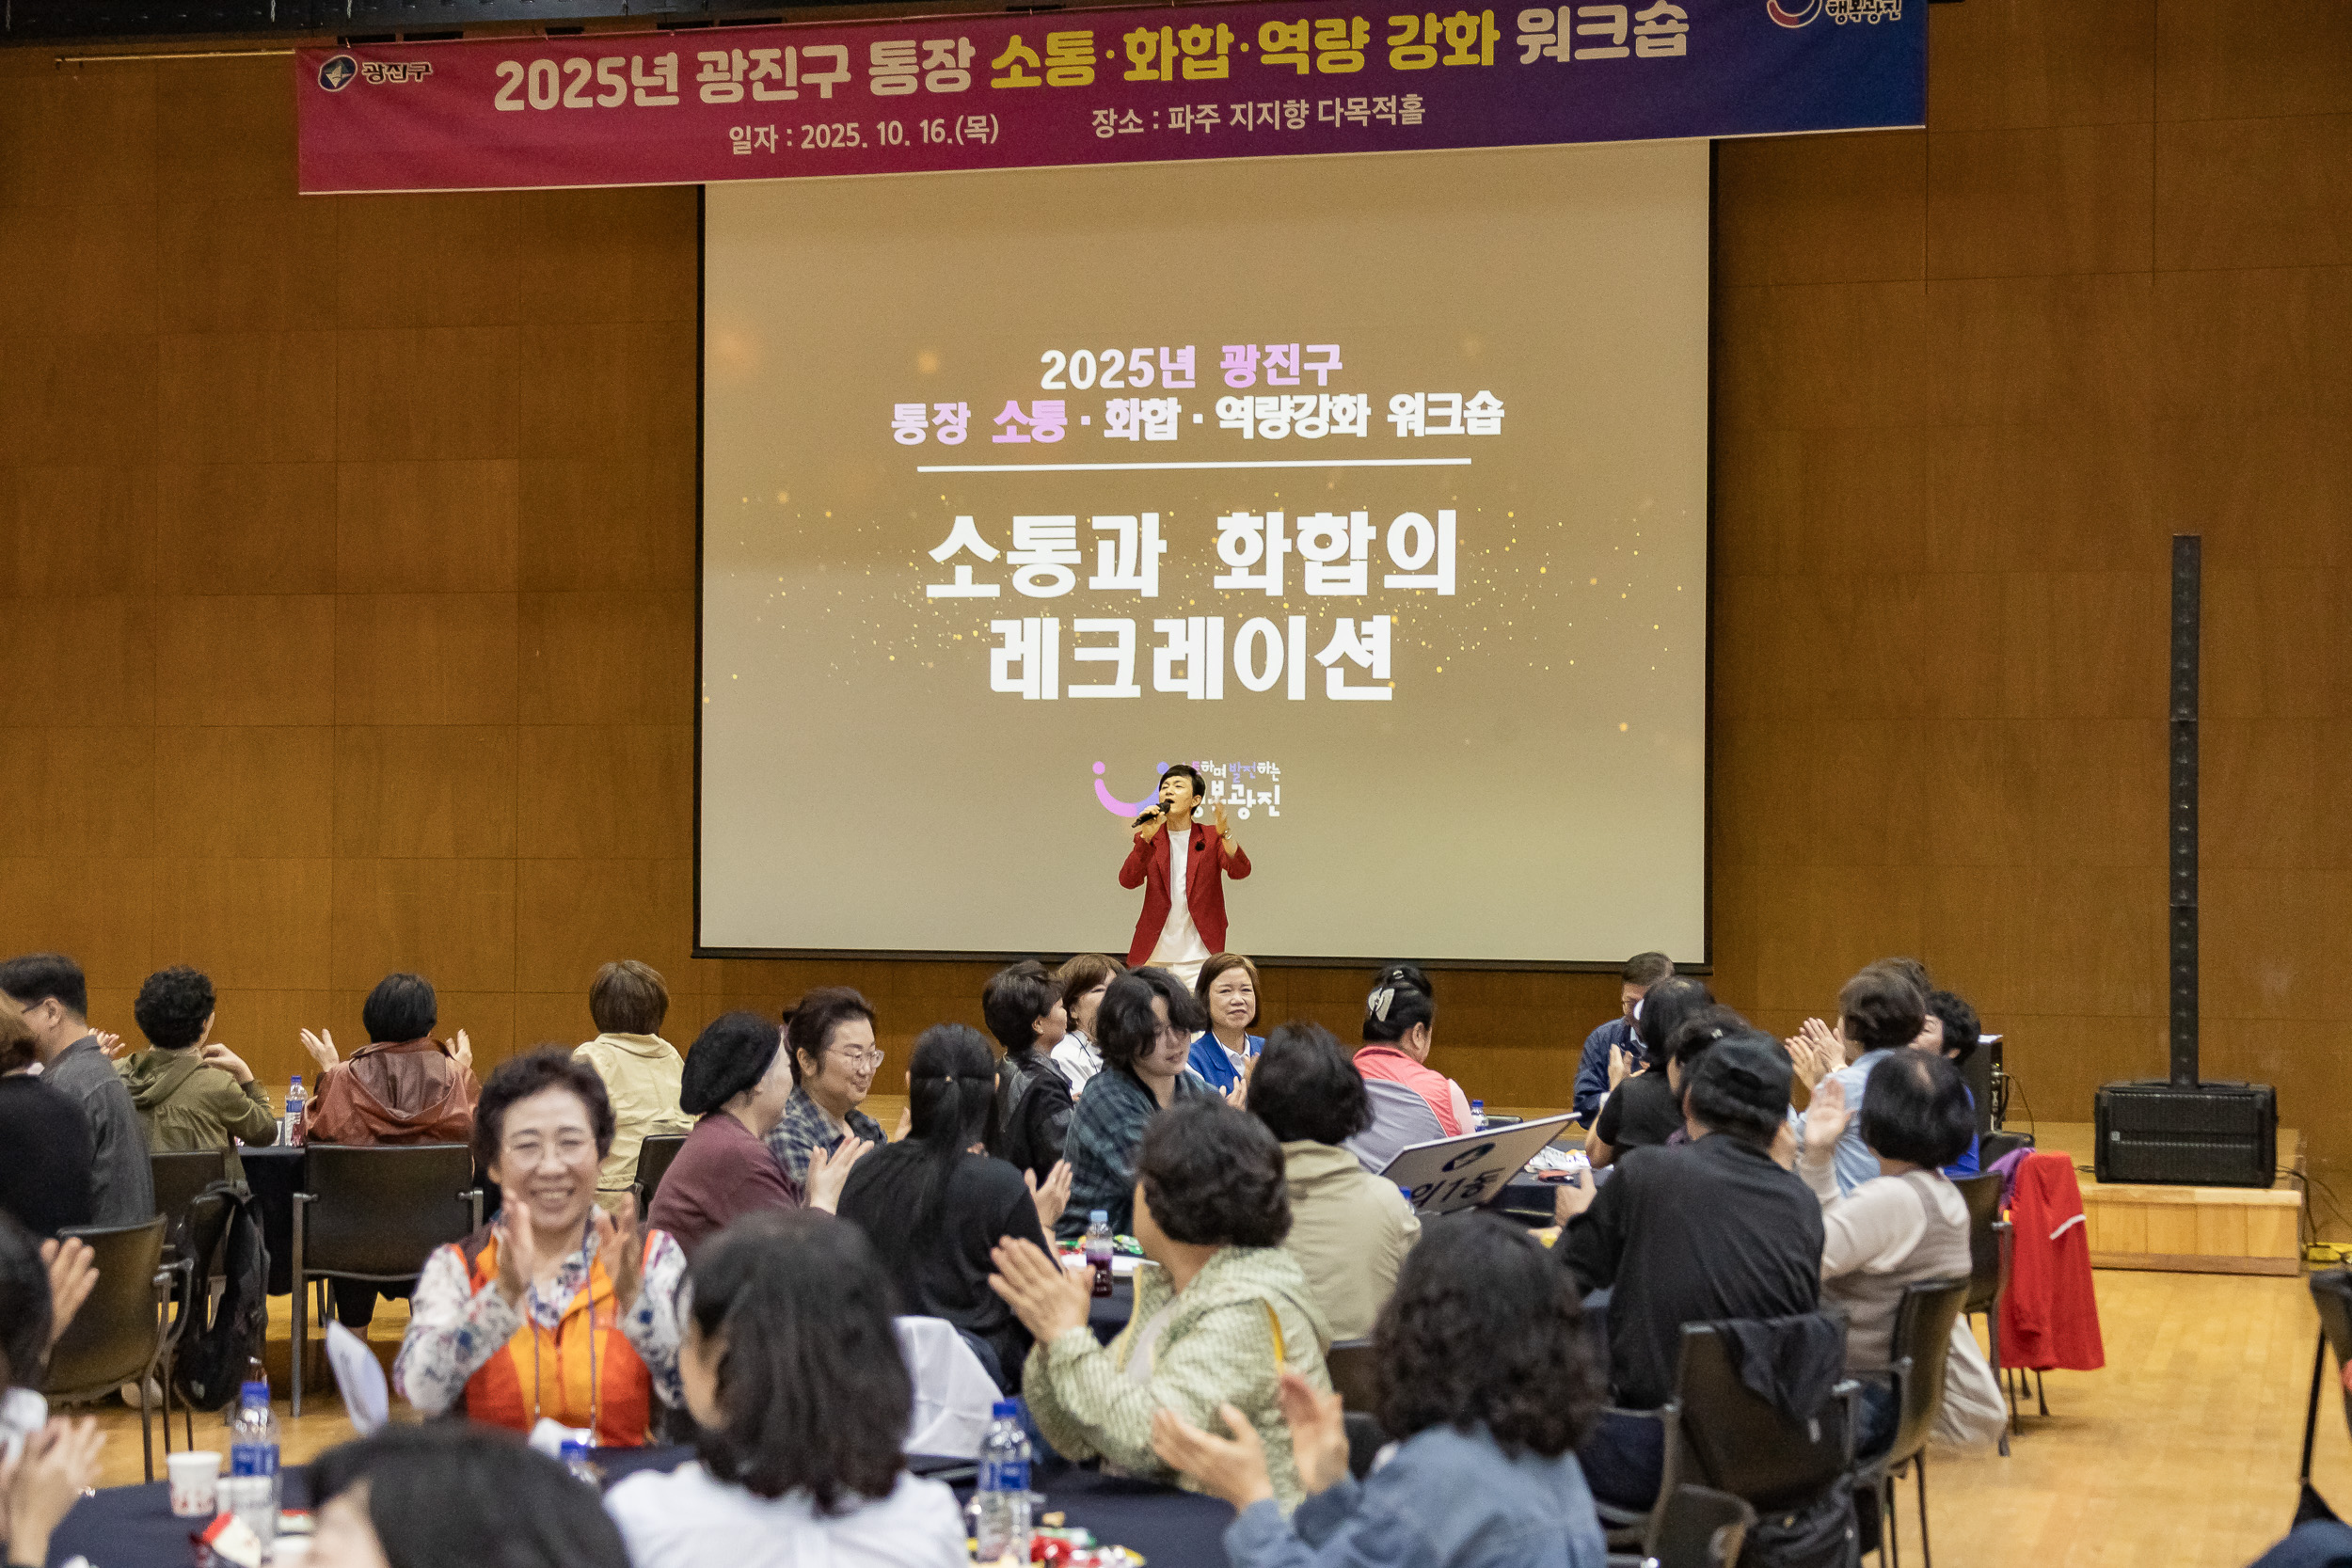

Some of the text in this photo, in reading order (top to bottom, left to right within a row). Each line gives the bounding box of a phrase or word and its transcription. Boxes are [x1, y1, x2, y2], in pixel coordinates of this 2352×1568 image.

[361, 61, 434, 85] 광진구
[494, 51, 680, 112] 2025년
[695, 44, 851, 104] 광진구
[867, 36, 977, 96] 통장
[1387, 9, 1502, 71] 강화
[1516, 0, 1690, 65] 워크숍
[728, 124, 779, 155] 일자
[801, 122, 868, 150] 2025.
[876, 119, 911, 147] 10.
[1091, 107, 1145, 138] 장소
[1168, 103, 1221, 135] 파주
[1229, 99, 1310, 132] 지지향
[1318, 93, 1426, 128] 다목적홀
[1041, 342, 1343, 390] 2025년 광진구
[891, 402, 972, 446] 통장
[1387, 389, 1505, 437] 워크숍
[926, 509, 1457, 598] 소통과 화합의
[990, 614, 1393, 702] 레크레이션
[1192, 780, 1280, 820] 복광진
